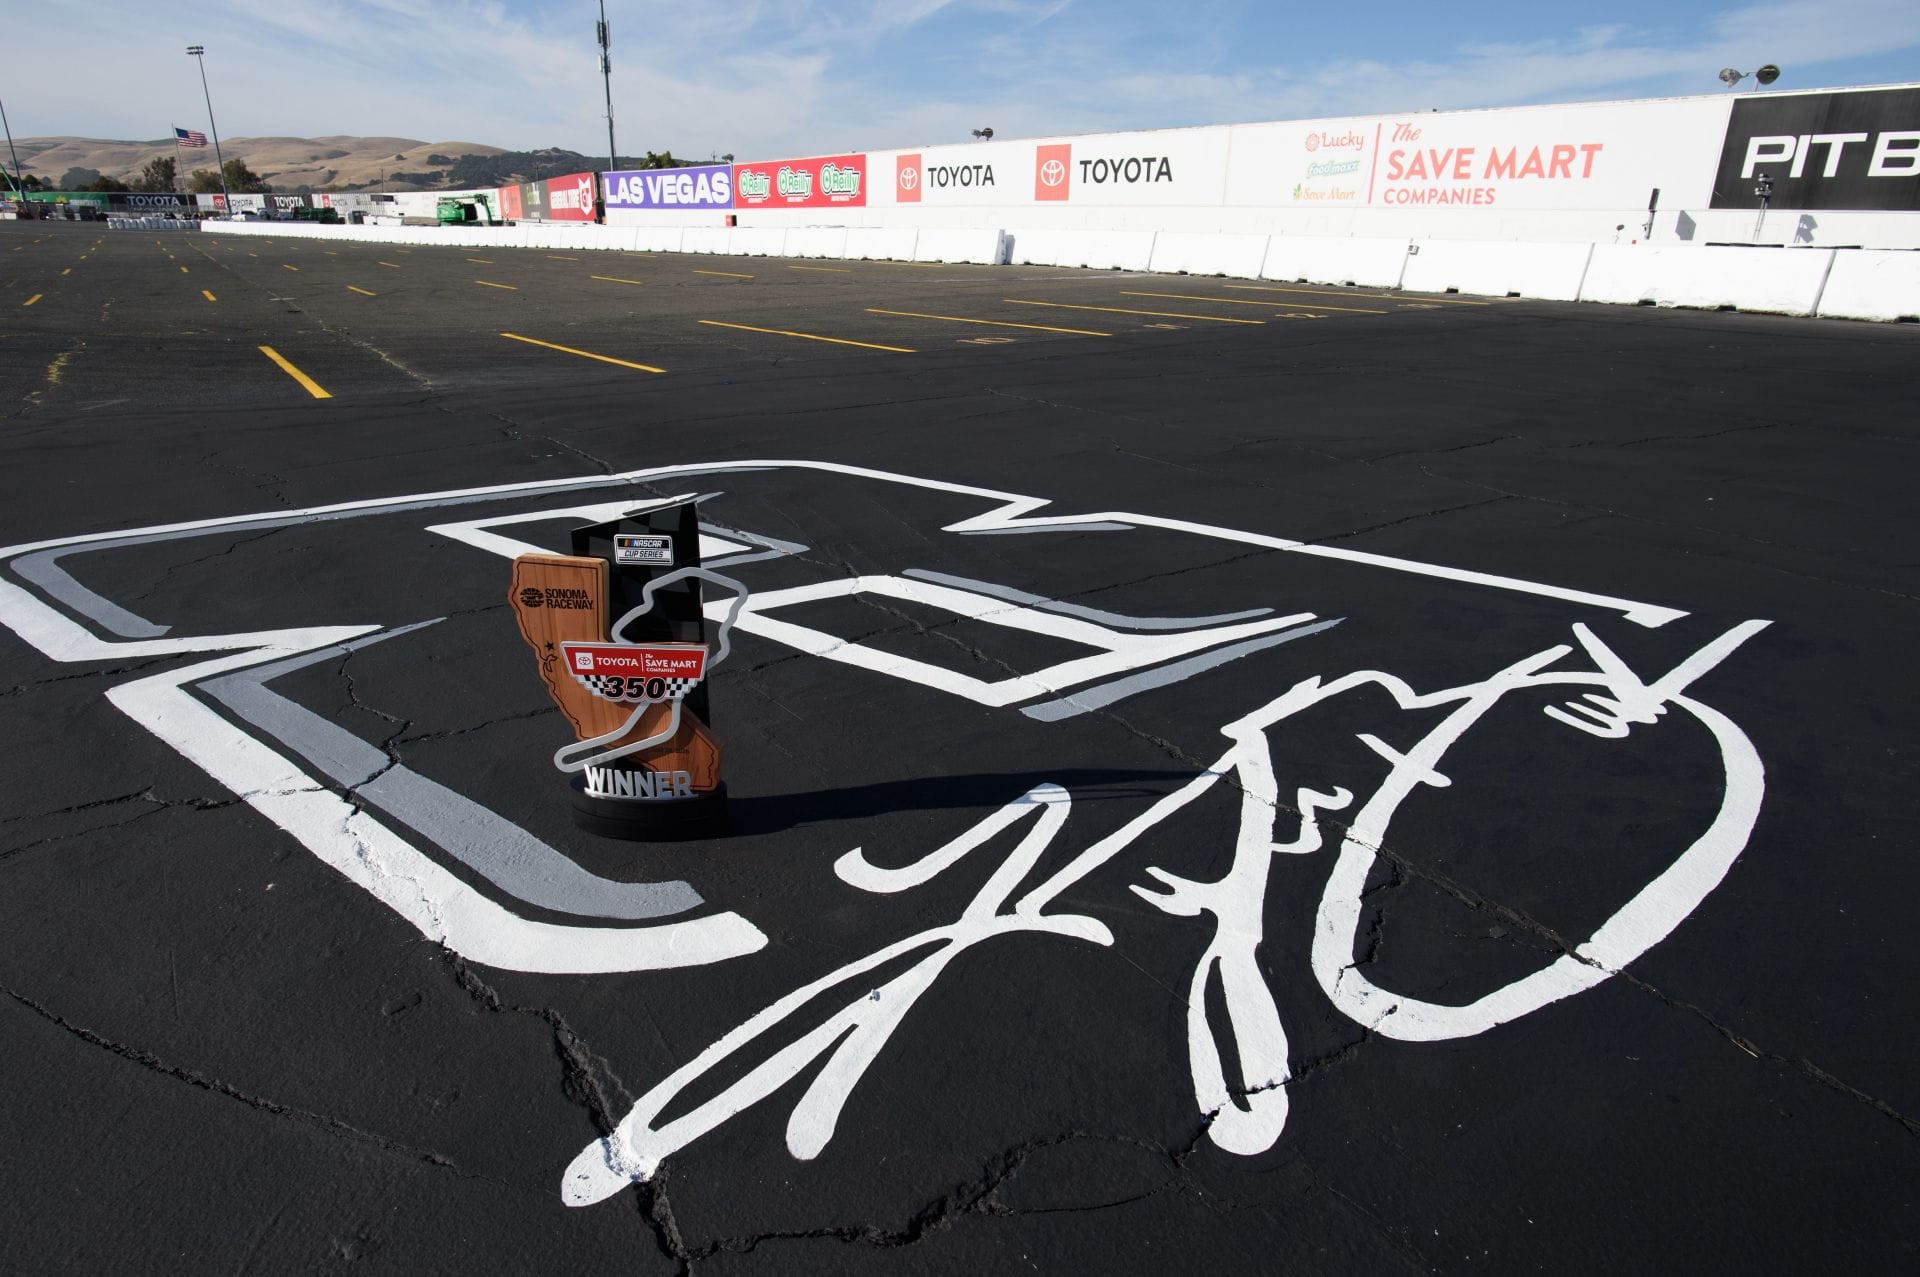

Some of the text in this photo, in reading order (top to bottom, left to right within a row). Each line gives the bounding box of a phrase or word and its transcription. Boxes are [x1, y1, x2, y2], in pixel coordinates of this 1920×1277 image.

[1321, 130, 1364, 151] Lucky
[1392, 123, 1422, 143] The
[1386, 143, 1604, 181] SAVE MART
[1741, 132, 1868, 179] PIT
[927, 164, 995, 188] TOYOTA
[1079, 156, 1173, 184] TOYOTA
[604, 171, 730, 205] LAS VEGAS
[1384, 187, 1496, 205] COMPANIES
[127, 195, 181, 207] TOYOTA
[274, 196, 304, 208] TOYOTA
[633, 539, 662, 548] NASCAR
[624, 550, 663, 558] CUP SERIES
[545, 588, 588, 600] SONOMA
[546, 599, 593, 610] RACEWAY
[596, 656, 639, 667] TOYOTA
[645, 659, 697, 668] SAVE MART
[604, 675, 667, 699] 350
[583, 764, 697, 799] WINNER
